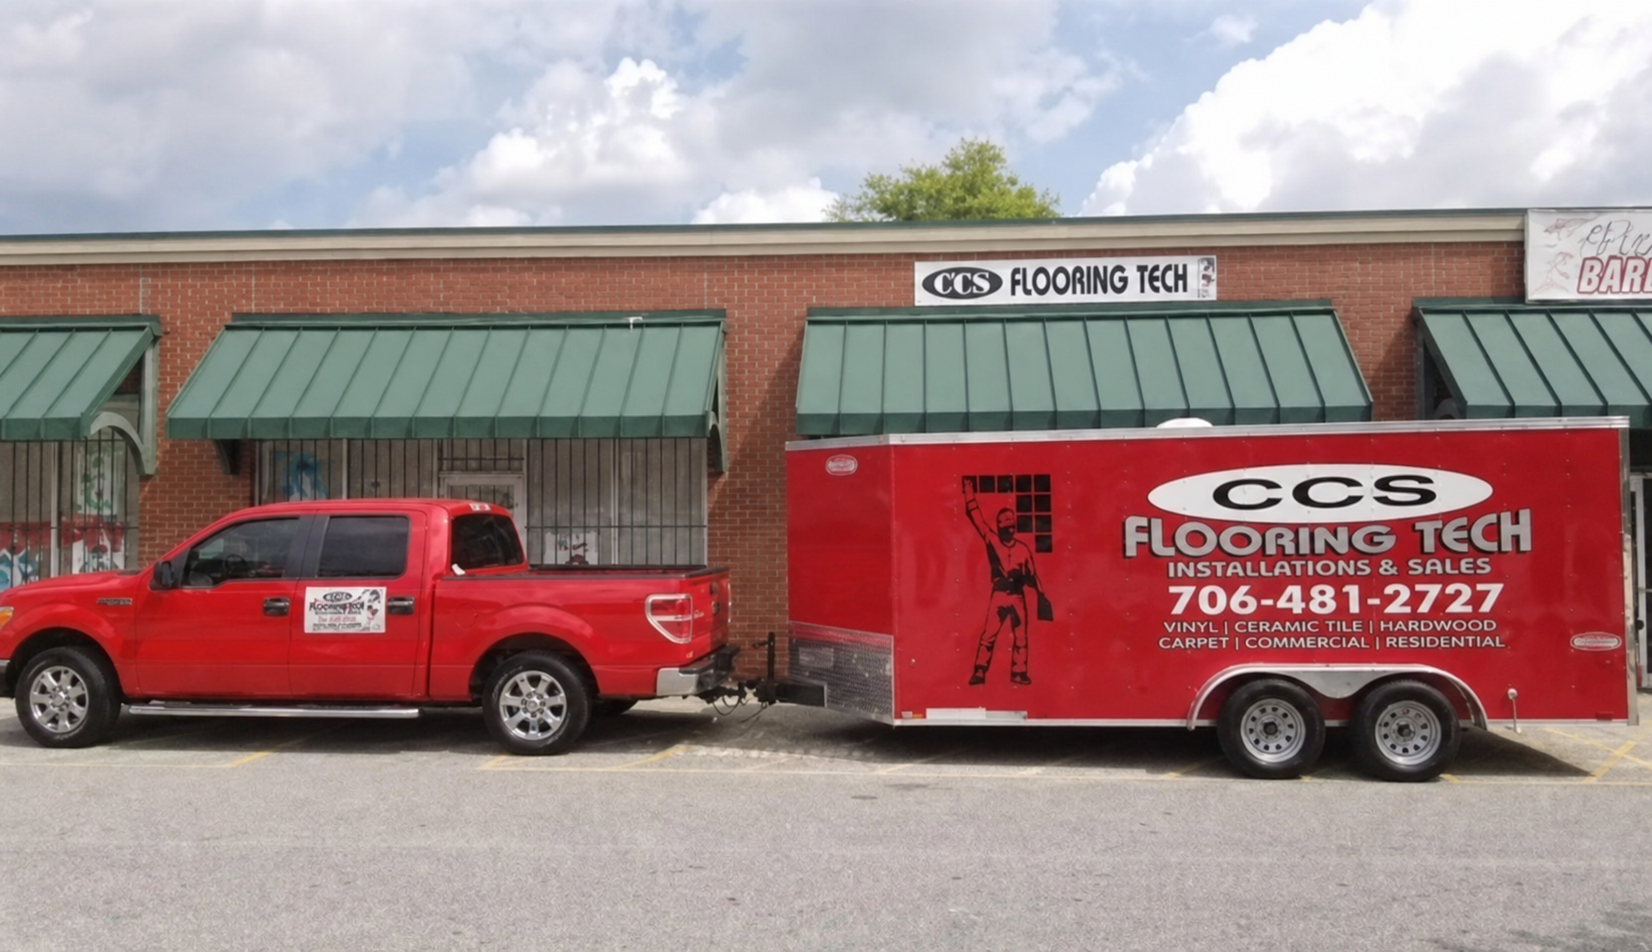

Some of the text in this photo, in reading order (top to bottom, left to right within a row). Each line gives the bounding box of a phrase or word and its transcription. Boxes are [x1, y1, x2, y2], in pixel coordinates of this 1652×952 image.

[933, 263, 1188, 296] CCS FLOORING TECH
[1213, 474, 1436, 510] CCS
[1124, 508, 1532, 558] FLOORING TECH
[1168, 557, 1492, 578] INSTALLATIONS & SALES
[1168, 583, 1504, 615] 706-481-2727
[1163, 621, 1219, 633] VINYL
[1234, 620, 1320, 633] CERAMIC
[1325, 620, 1363, 632] TILE
[1380, 619, 1497, 632] HARDWOOD
[1158, 637, 1229, 649] CARPET
[1245, 636, 1370, 649] COMMERCIAL
[1386, 636, 1506, 648] RESIDENTIAL
